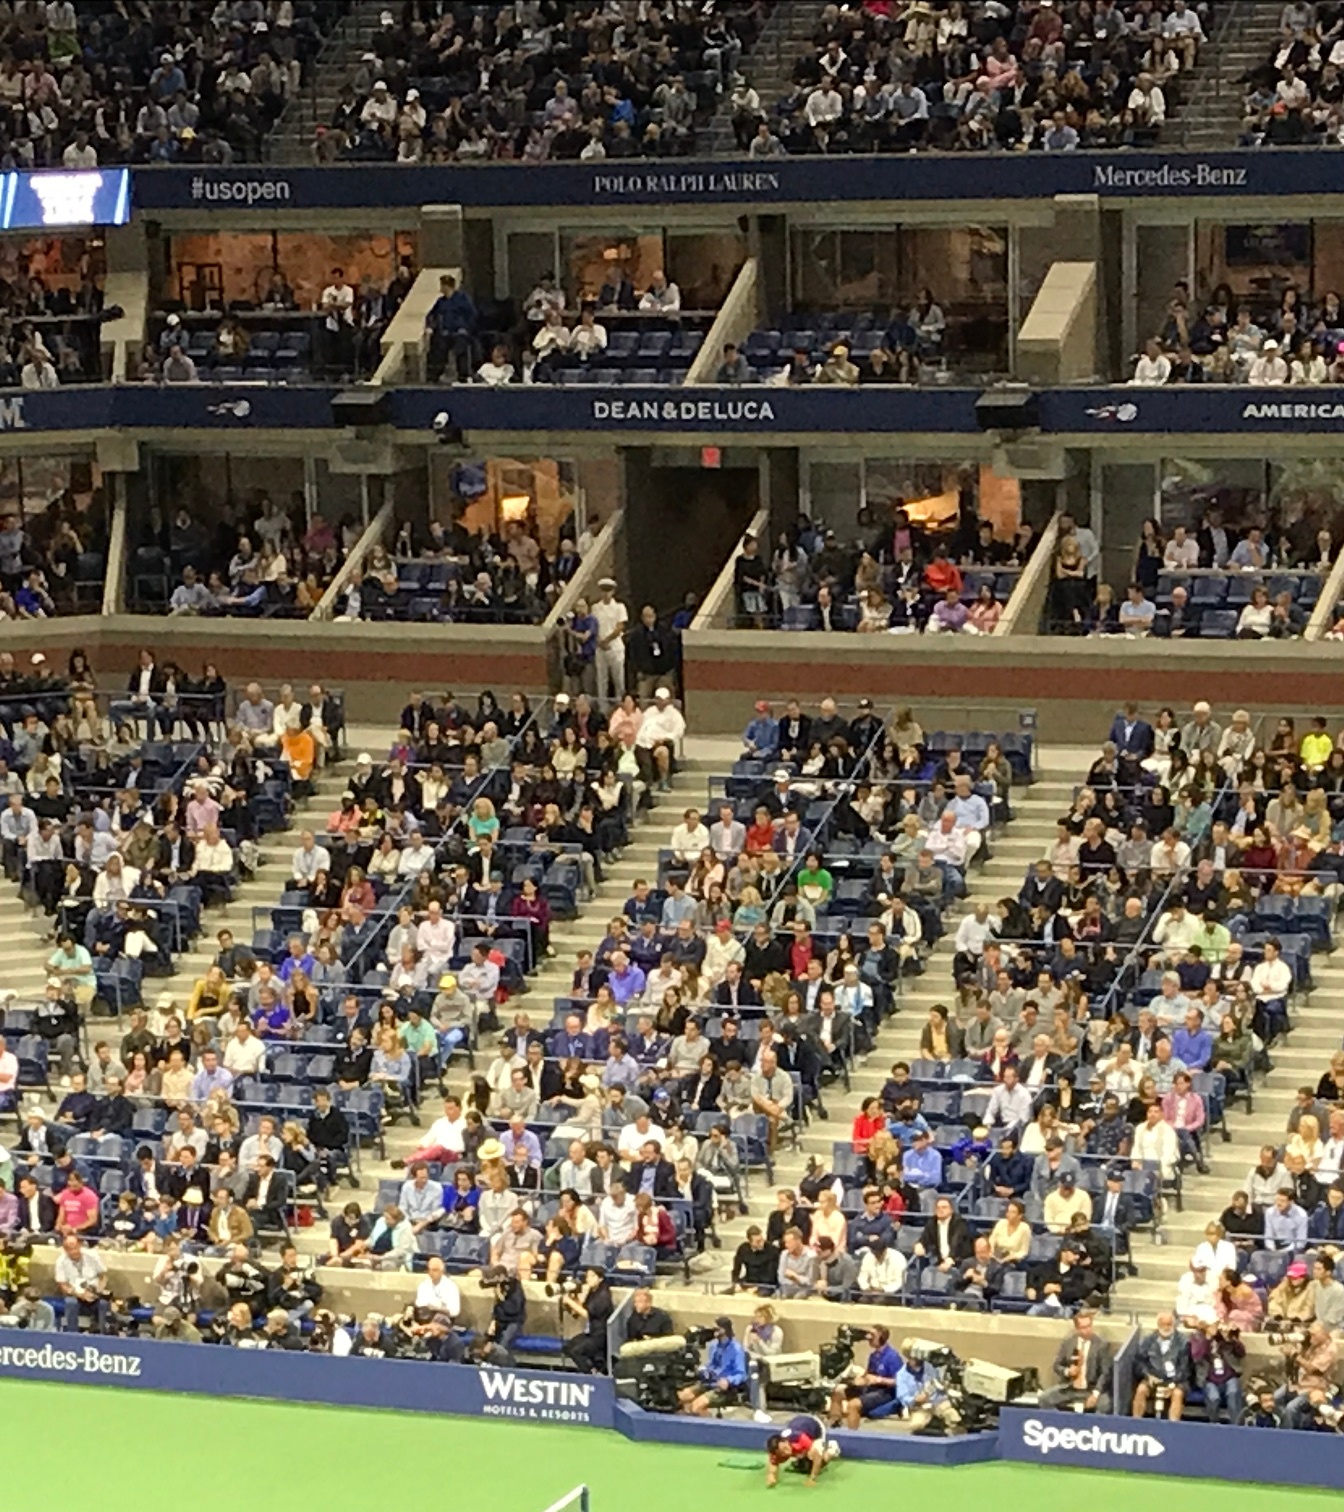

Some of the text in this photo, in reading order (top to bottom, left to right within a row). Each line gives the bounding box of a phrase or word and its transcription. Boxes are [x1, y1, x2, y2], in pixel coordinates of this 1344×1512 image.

[594, 172, 780, 193] POLO RALPH LAUREN
[1093, 163, 1247, 188] Mercedes-Benz
[190, 176, 290, 203] #usopen
[478, 1370, 590, 1407] WESTIN
[1023, 1419, 1155, 1457] Spectrum
